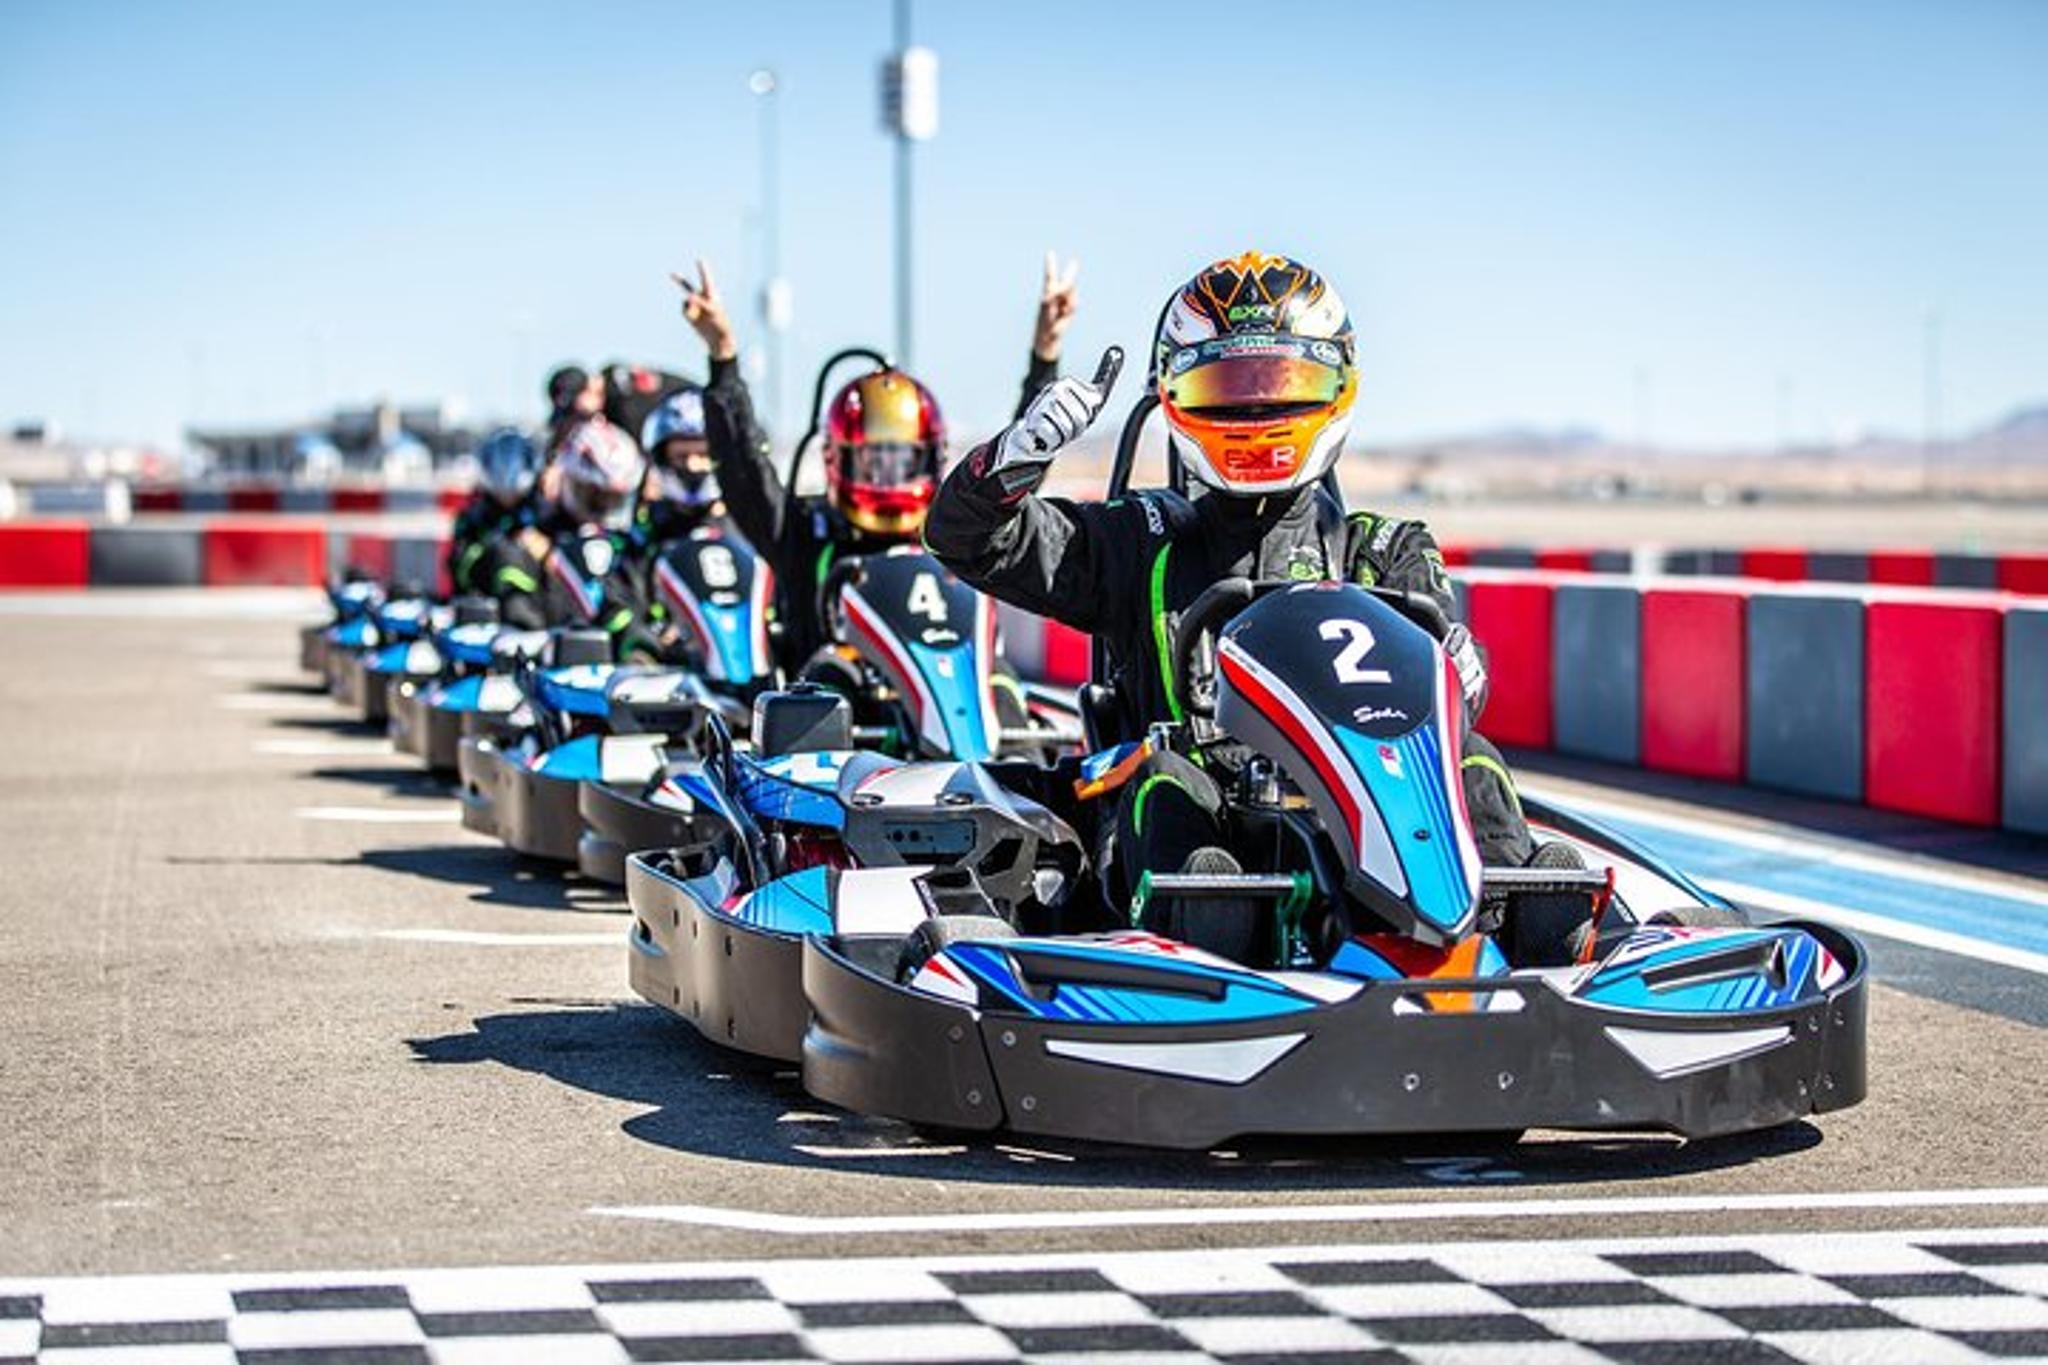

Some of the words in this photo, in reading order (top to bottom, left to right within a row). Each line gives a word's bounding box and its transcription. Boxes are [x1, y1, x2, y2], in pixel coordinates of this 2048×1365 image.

[1224, 446, 1296, 469] EXR
[907, 572, 947, 621] 4
[1318, 619, 1392, 684] 2
